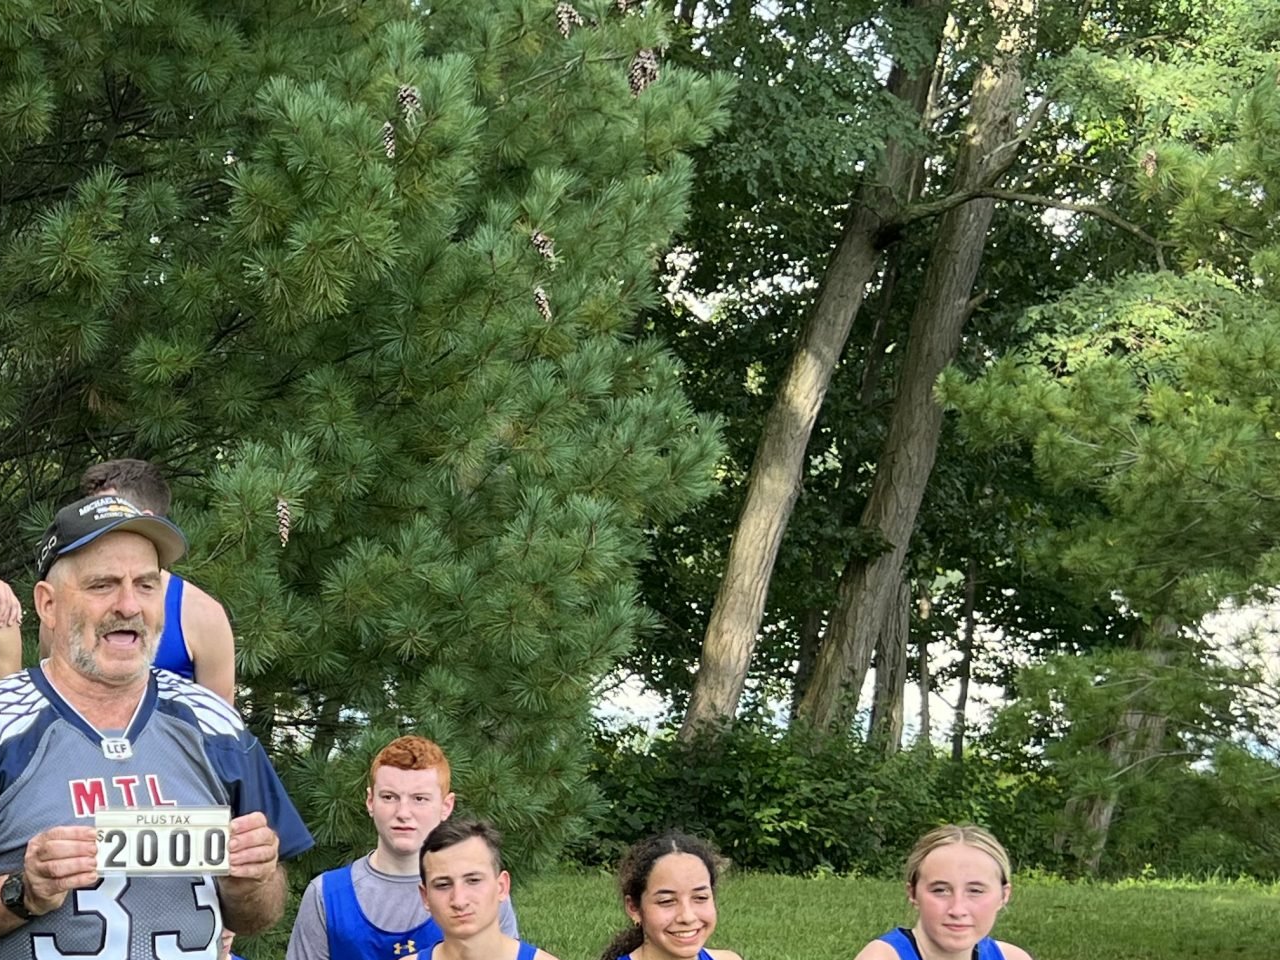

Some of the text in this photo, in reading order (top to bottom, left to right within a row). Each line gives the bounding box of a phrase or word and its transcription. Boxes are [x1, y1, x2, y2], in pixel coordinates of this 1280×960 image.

[69, 774, 178, 819] MTL
[136, 814, 191, 825] PLUS TAX
